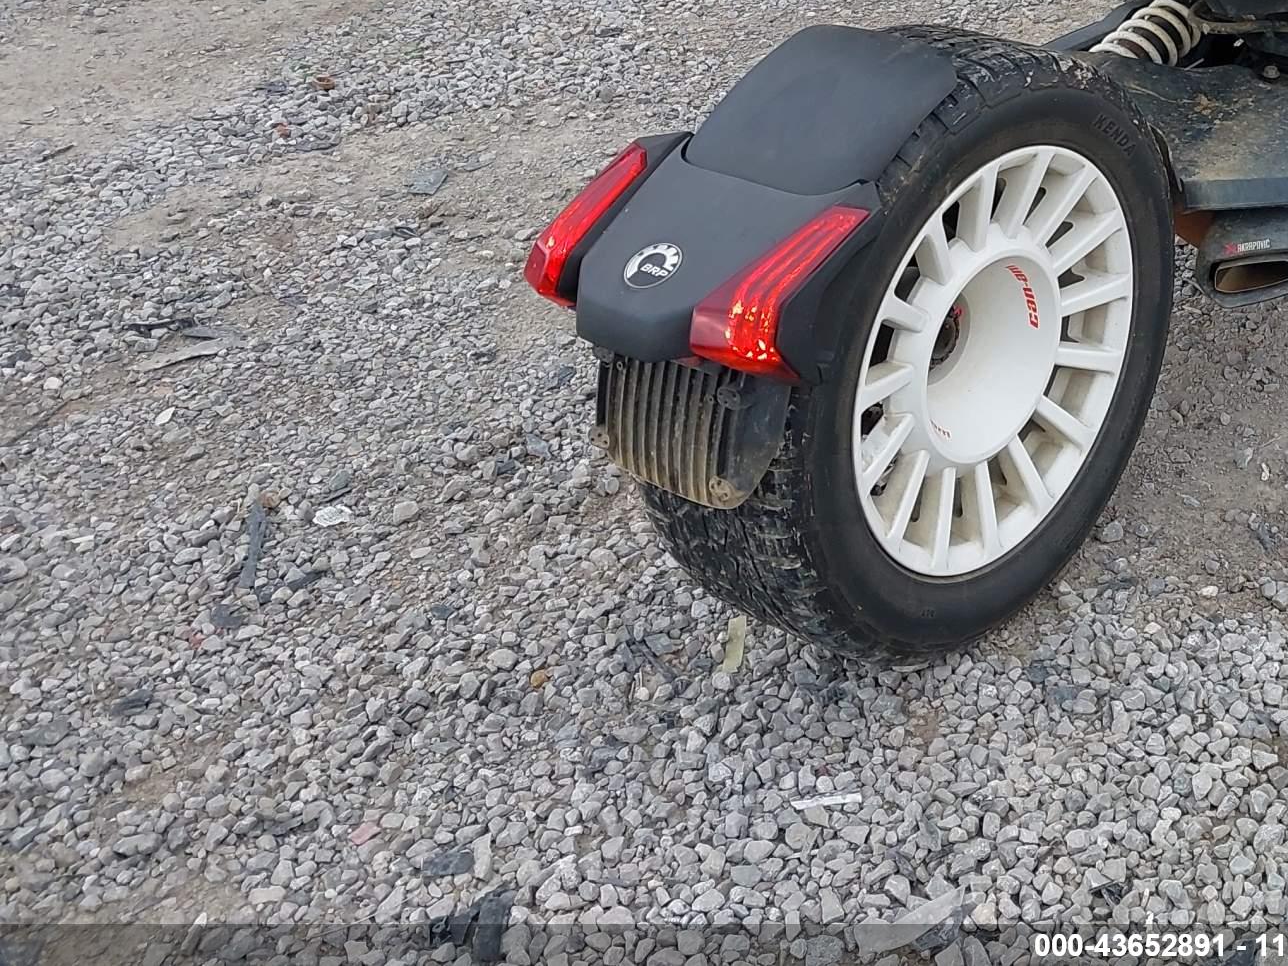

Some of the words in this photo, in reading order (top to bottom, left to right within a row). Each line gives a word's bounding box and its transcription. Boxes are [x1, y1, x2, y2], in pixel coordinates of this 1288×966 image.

[1094, 114, 1137, 156] KENDA
[639, 263, 669, 277] BRP
[1004, 264, 1039, 329] can-am
